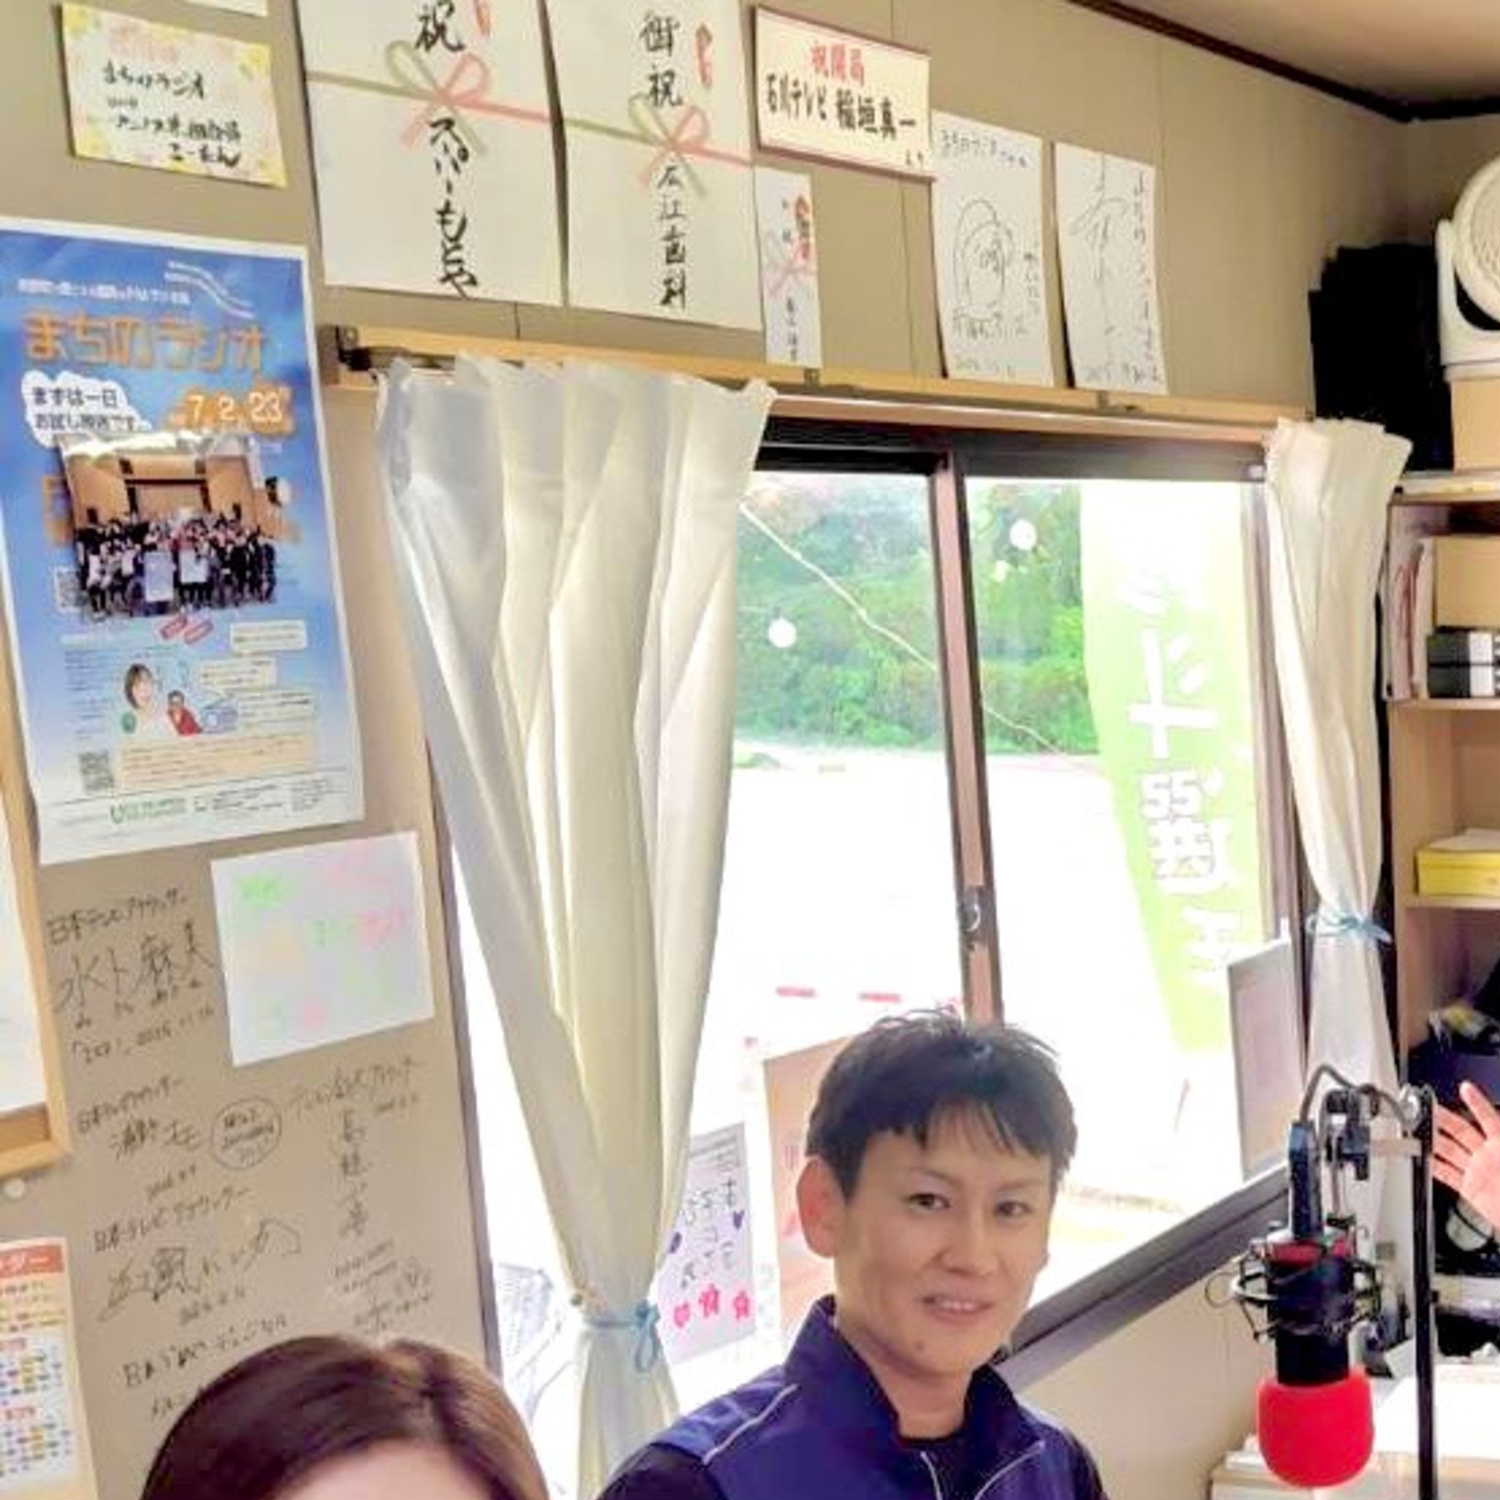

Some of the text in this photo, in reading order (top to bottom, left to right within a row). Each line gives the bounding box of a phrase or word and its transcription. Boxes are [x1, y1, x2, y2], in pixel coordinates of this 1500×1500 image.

[22, 308, 270, 372] まちのラジオ
[32, 386, 118, 409] まずは一日
